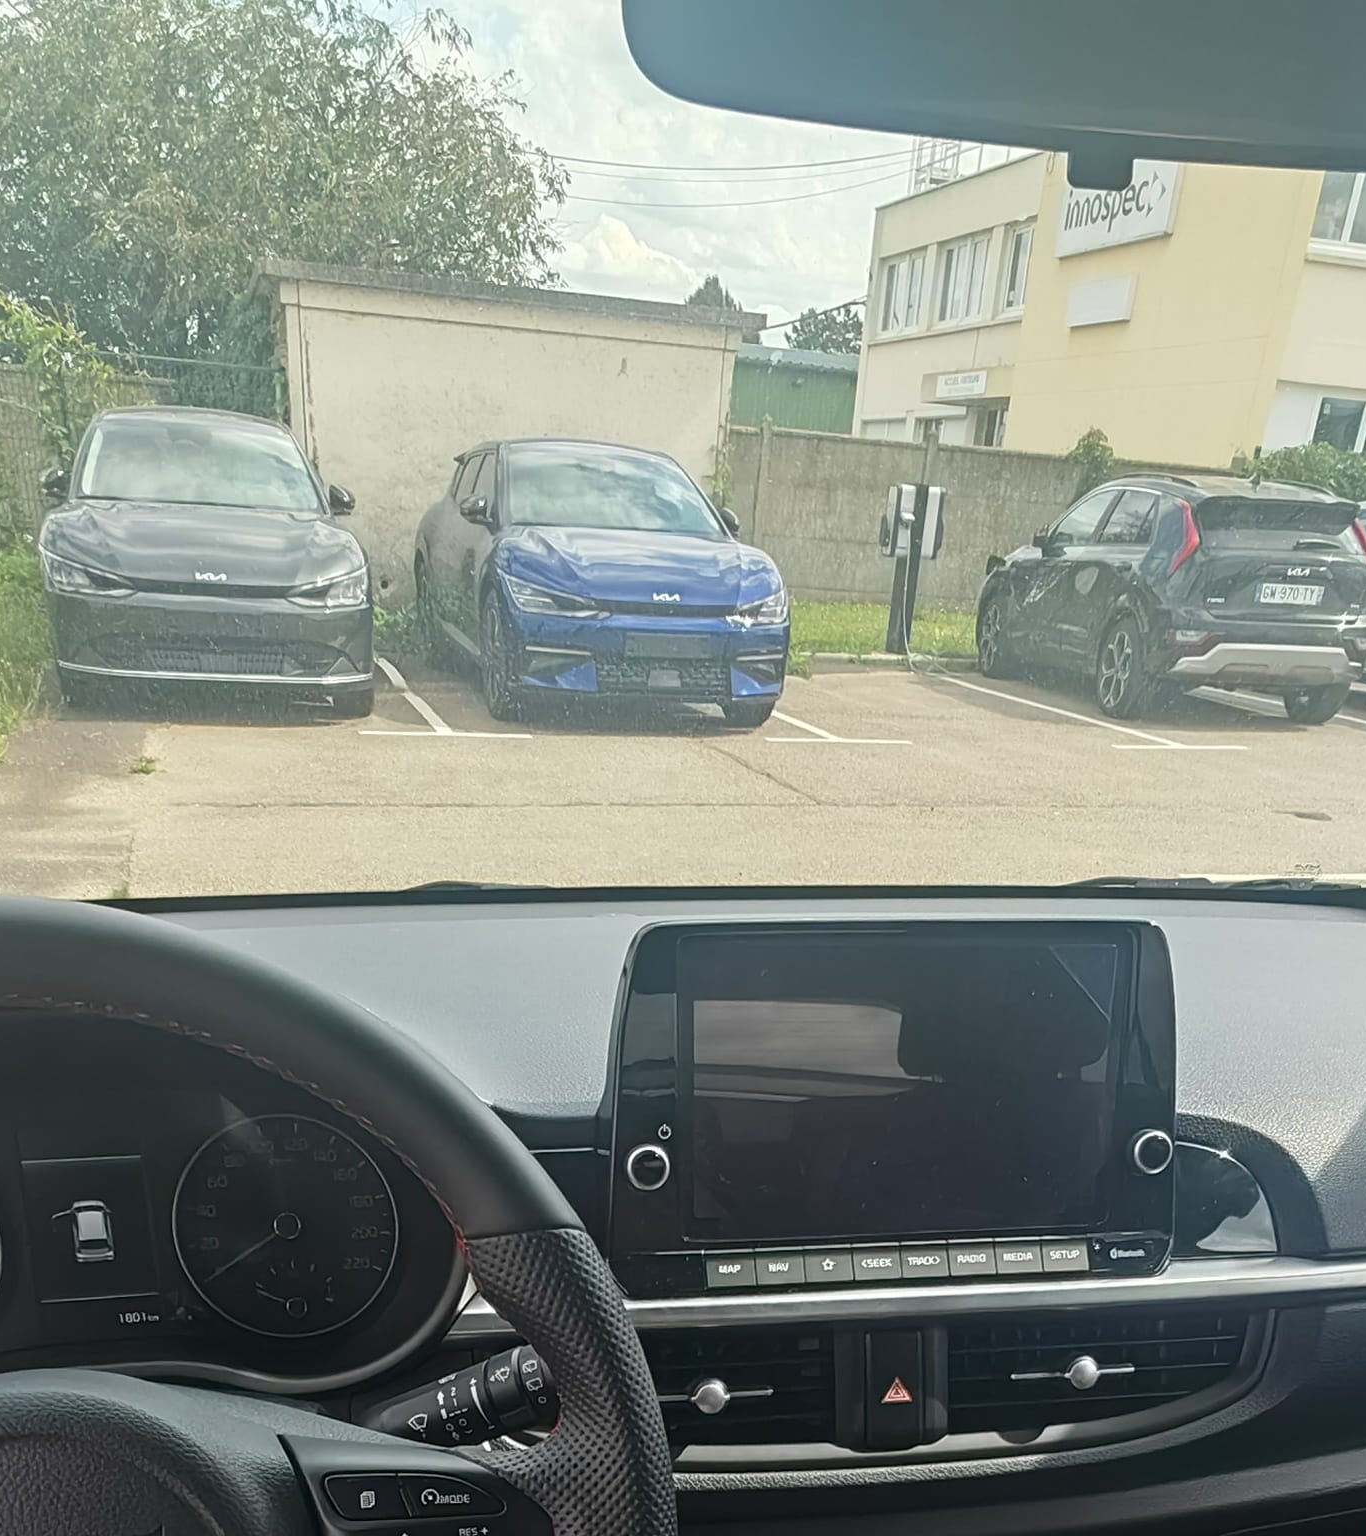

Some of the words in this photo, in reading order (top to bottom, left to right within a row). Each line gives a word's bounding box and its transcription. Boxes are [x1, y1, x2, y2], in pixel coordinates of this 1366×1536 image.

[652, 592, 681, 602] KIA
[957, 1253, 987, 1264] RADIO
[1003, 1251, 1033, 1262] MEDIA
[1050, 1249, 1080, 1260] SETUP
[718, 1264, 741, 1274] MAP
[768, 1262, 789, 1273] NAV
[440, 1493, 471, 1504] MODE
[458, 1527, 478, 1536] RES
